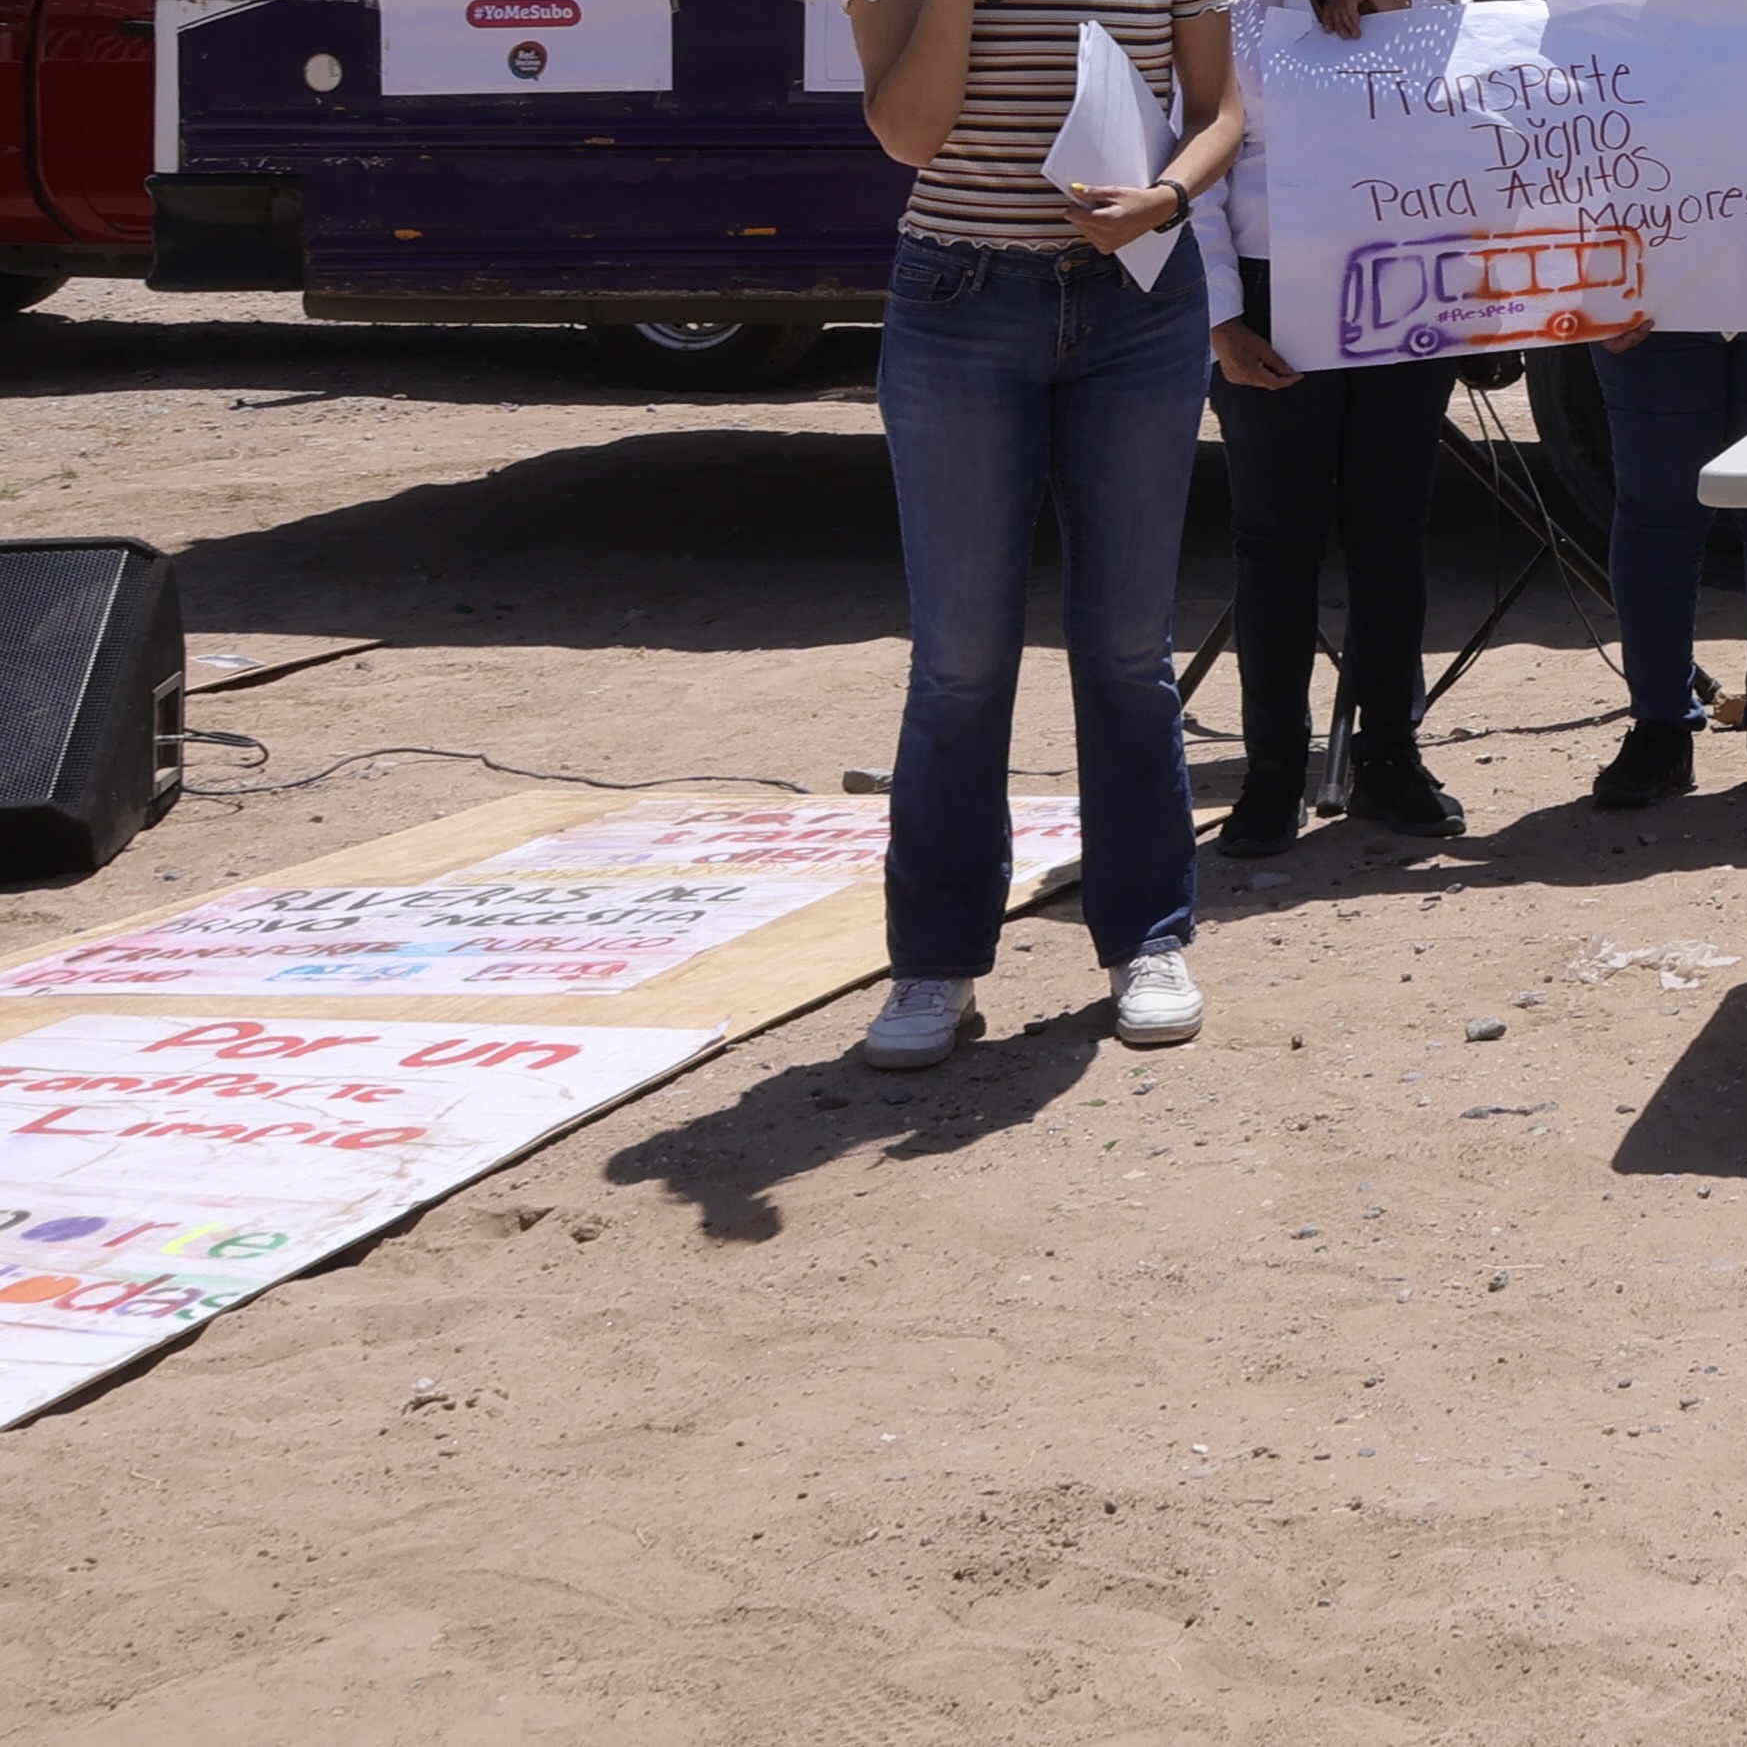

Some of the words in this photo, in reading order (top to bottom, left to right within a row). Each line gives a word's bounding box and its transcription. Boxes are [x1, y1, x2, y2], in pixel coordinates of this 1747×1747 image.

[474, 4, 573, 20] #YoMeSubo
[1469, 109, 1632, 178] Digno
[1352, 176, 1478, 223] Para
[1434, 300, 1526, 325] #Respeto
[240, 885, 608, 913] RIVERAS
[634, 885, 748, 905] DEL
[145, 915, 361, 936] BRAVO
[64, 939, 414, 965] TRANSPORTE
[138, 1021, 384, 1061] Por
[399, 1037, 585, 1071] un
[0, 1210, 291, 1260] orte
